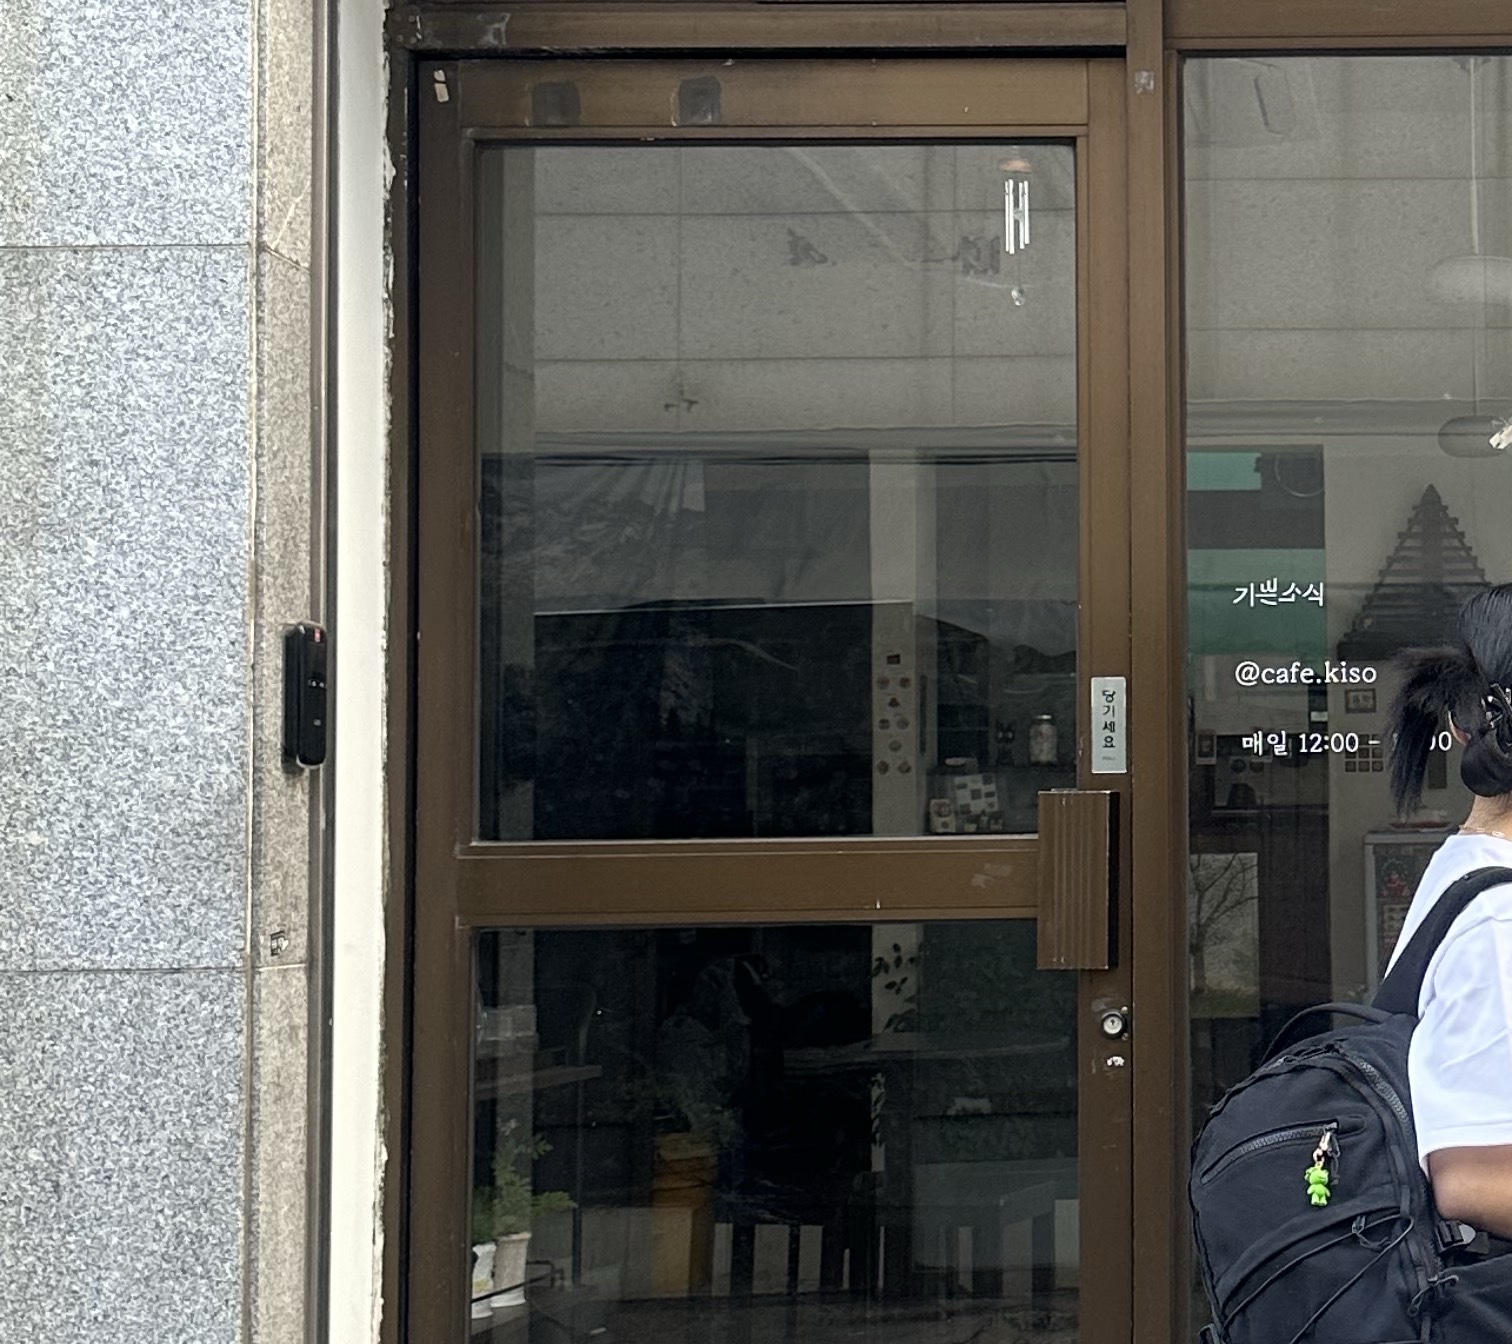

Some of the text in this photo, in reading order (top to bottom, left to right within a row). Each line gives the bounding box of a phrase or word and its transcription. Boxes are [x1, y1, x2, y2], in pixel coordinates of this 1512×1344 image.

[1232, 577, 1324, 607] 기쁜소식
[1235, 660, 1377, 686] @cafe.kiso
[1101, 689, 1116, 749] 당기세요
[1241, 730, 1288, 757] 매일
[1299, 732, 1359, 754] 12:00
